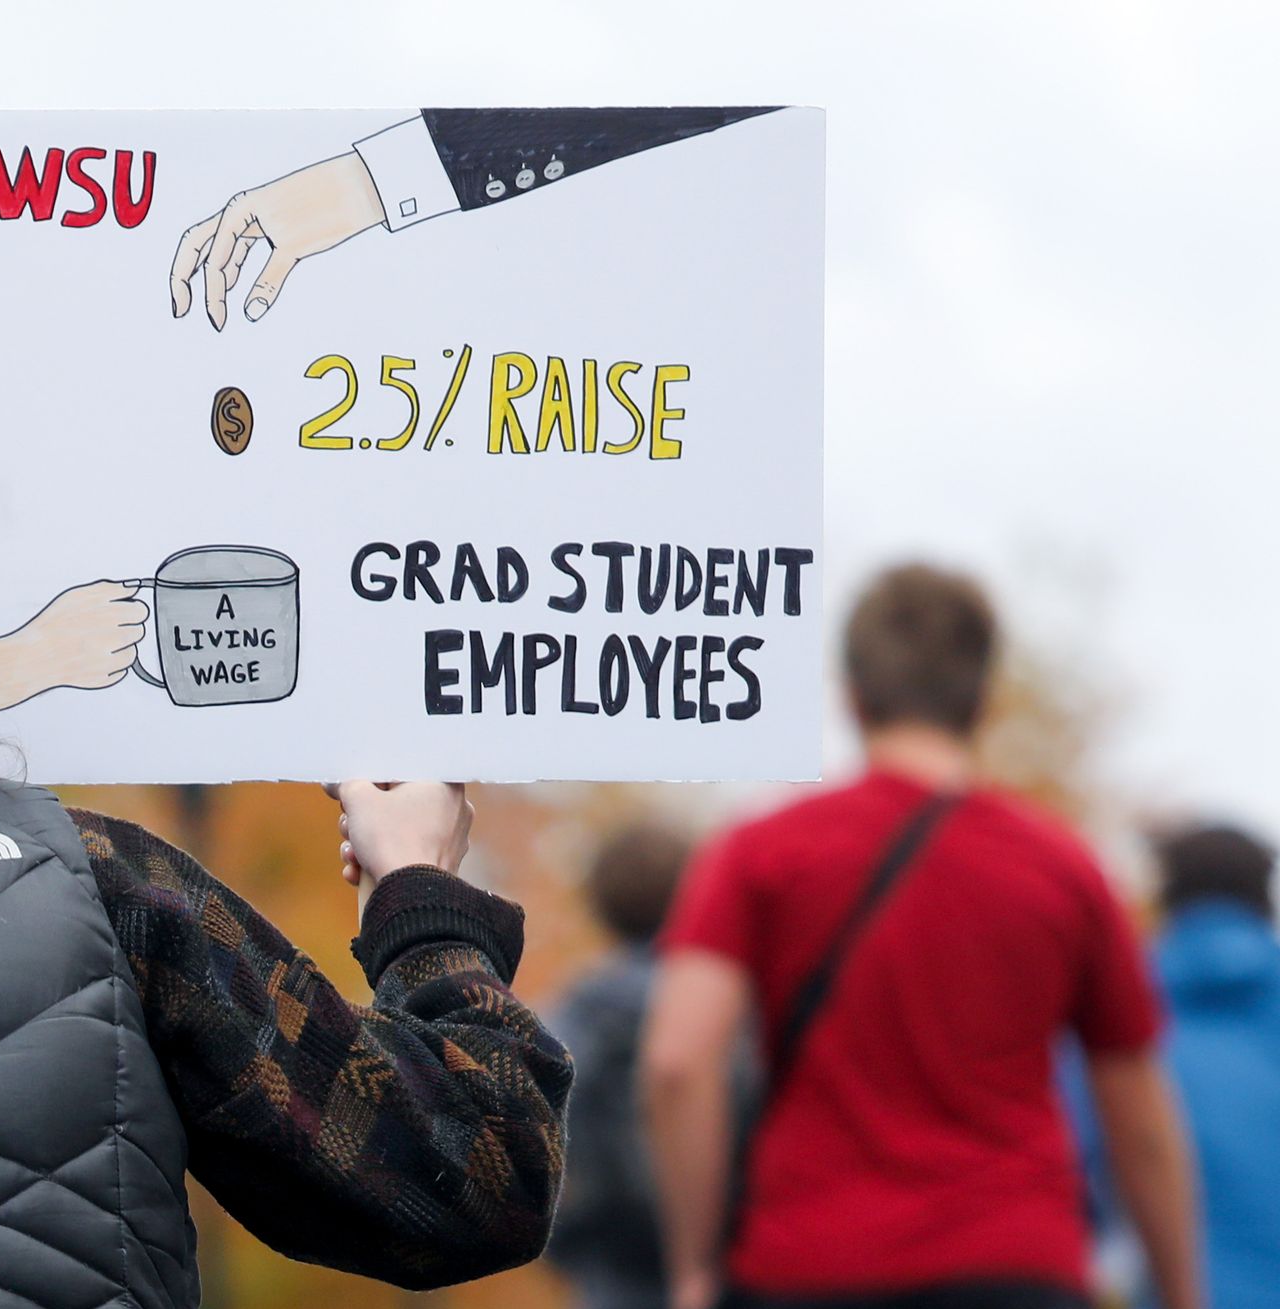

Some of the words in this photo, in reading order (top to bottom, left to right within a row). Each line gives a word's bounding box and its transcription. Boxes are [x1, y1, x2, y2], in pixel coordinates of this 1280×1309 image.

[299, 344, 472, 452] 2.5%
[487, 351, 691, 460] RAISE
[350, 541, 530, 603] GRAD
[548, 542, 814, 617] STUDENT
[216, 593, 235, 620] A
[174, 625, 276, 651] LIVING
[190, 660, 260, 687] WAGE
[424, 630, 765, 723] EMPLOYEES
